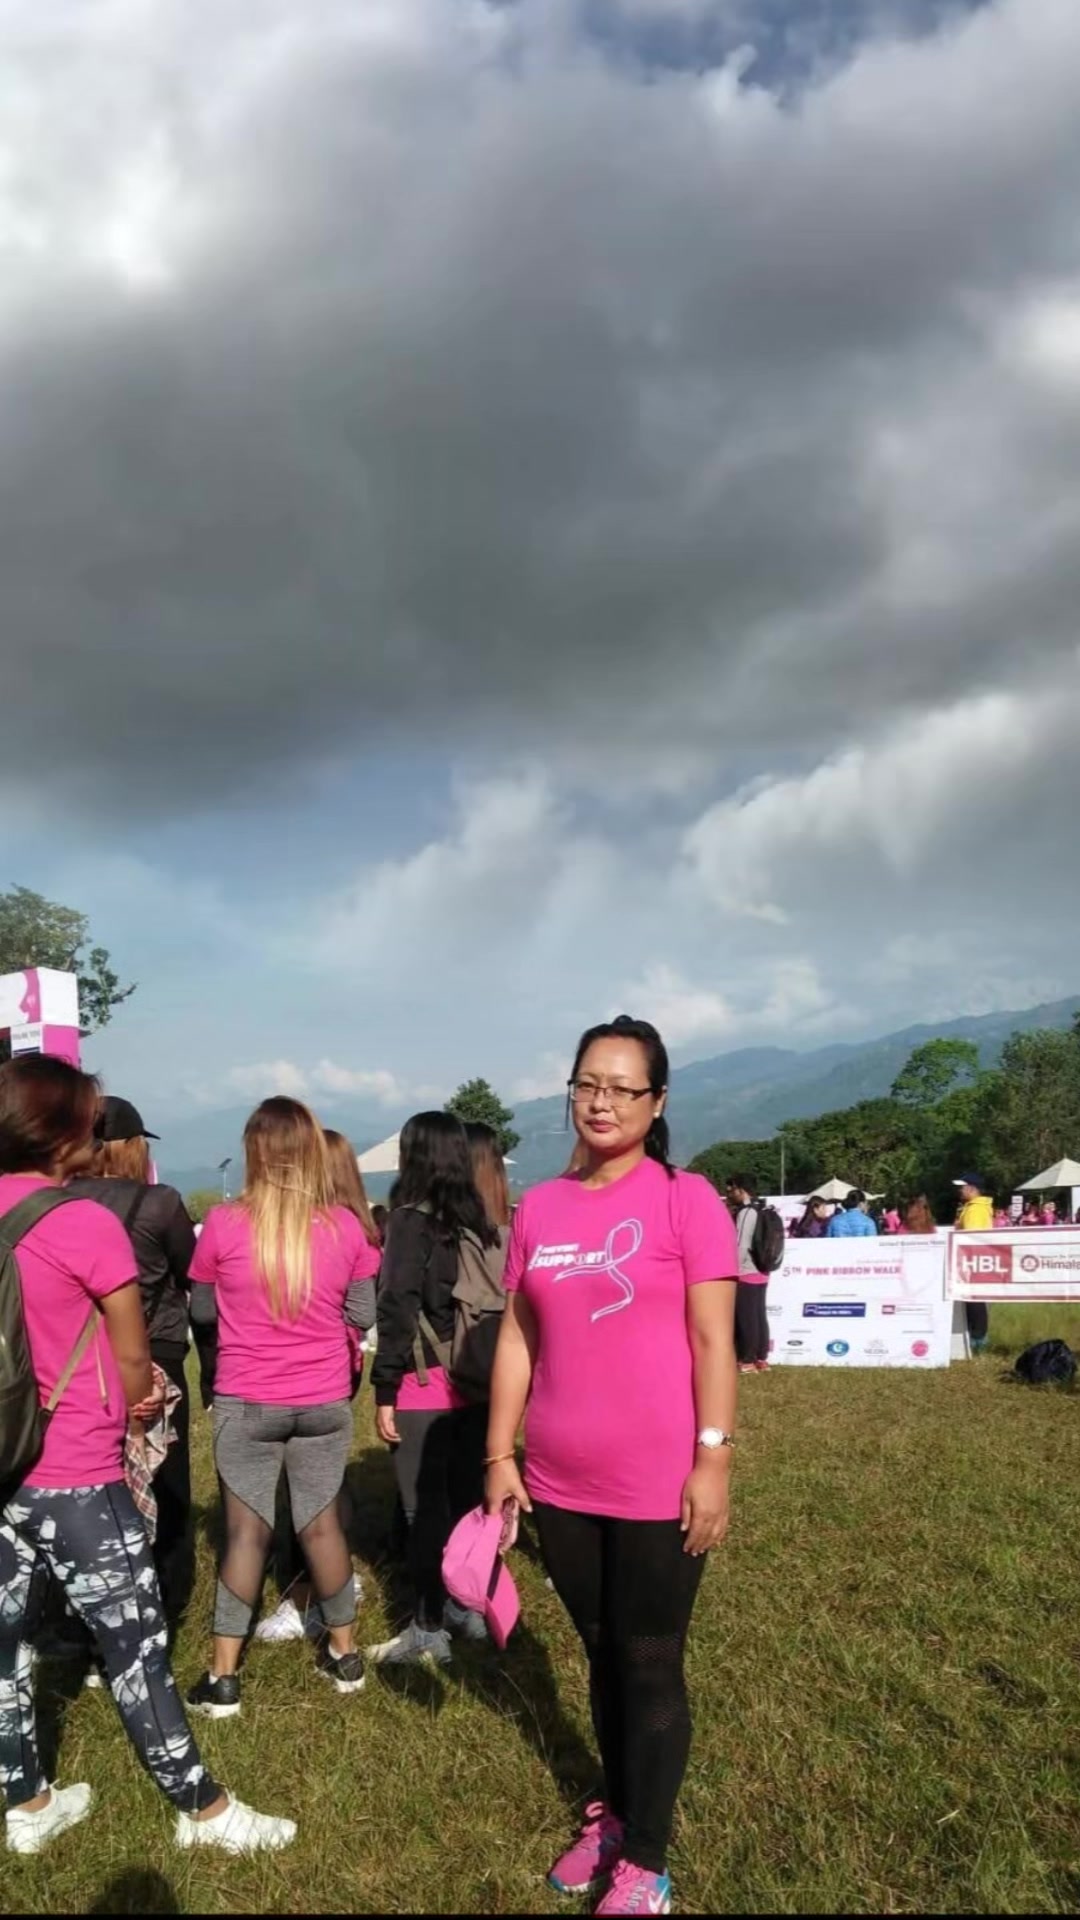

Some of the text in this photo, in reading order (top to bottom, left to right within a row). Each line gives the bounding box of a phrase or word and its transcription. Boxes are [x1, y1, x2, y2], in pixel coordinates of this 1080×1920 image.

[534, 1252, 605, 1267] SUPPORT
[962, 1255, 1009, 1273] HBL
[806, 1267, 829, 1275] PINK
[832, 1266, 871, 1275] RIBBON
[873, 1265, 901, 1274] WALK
